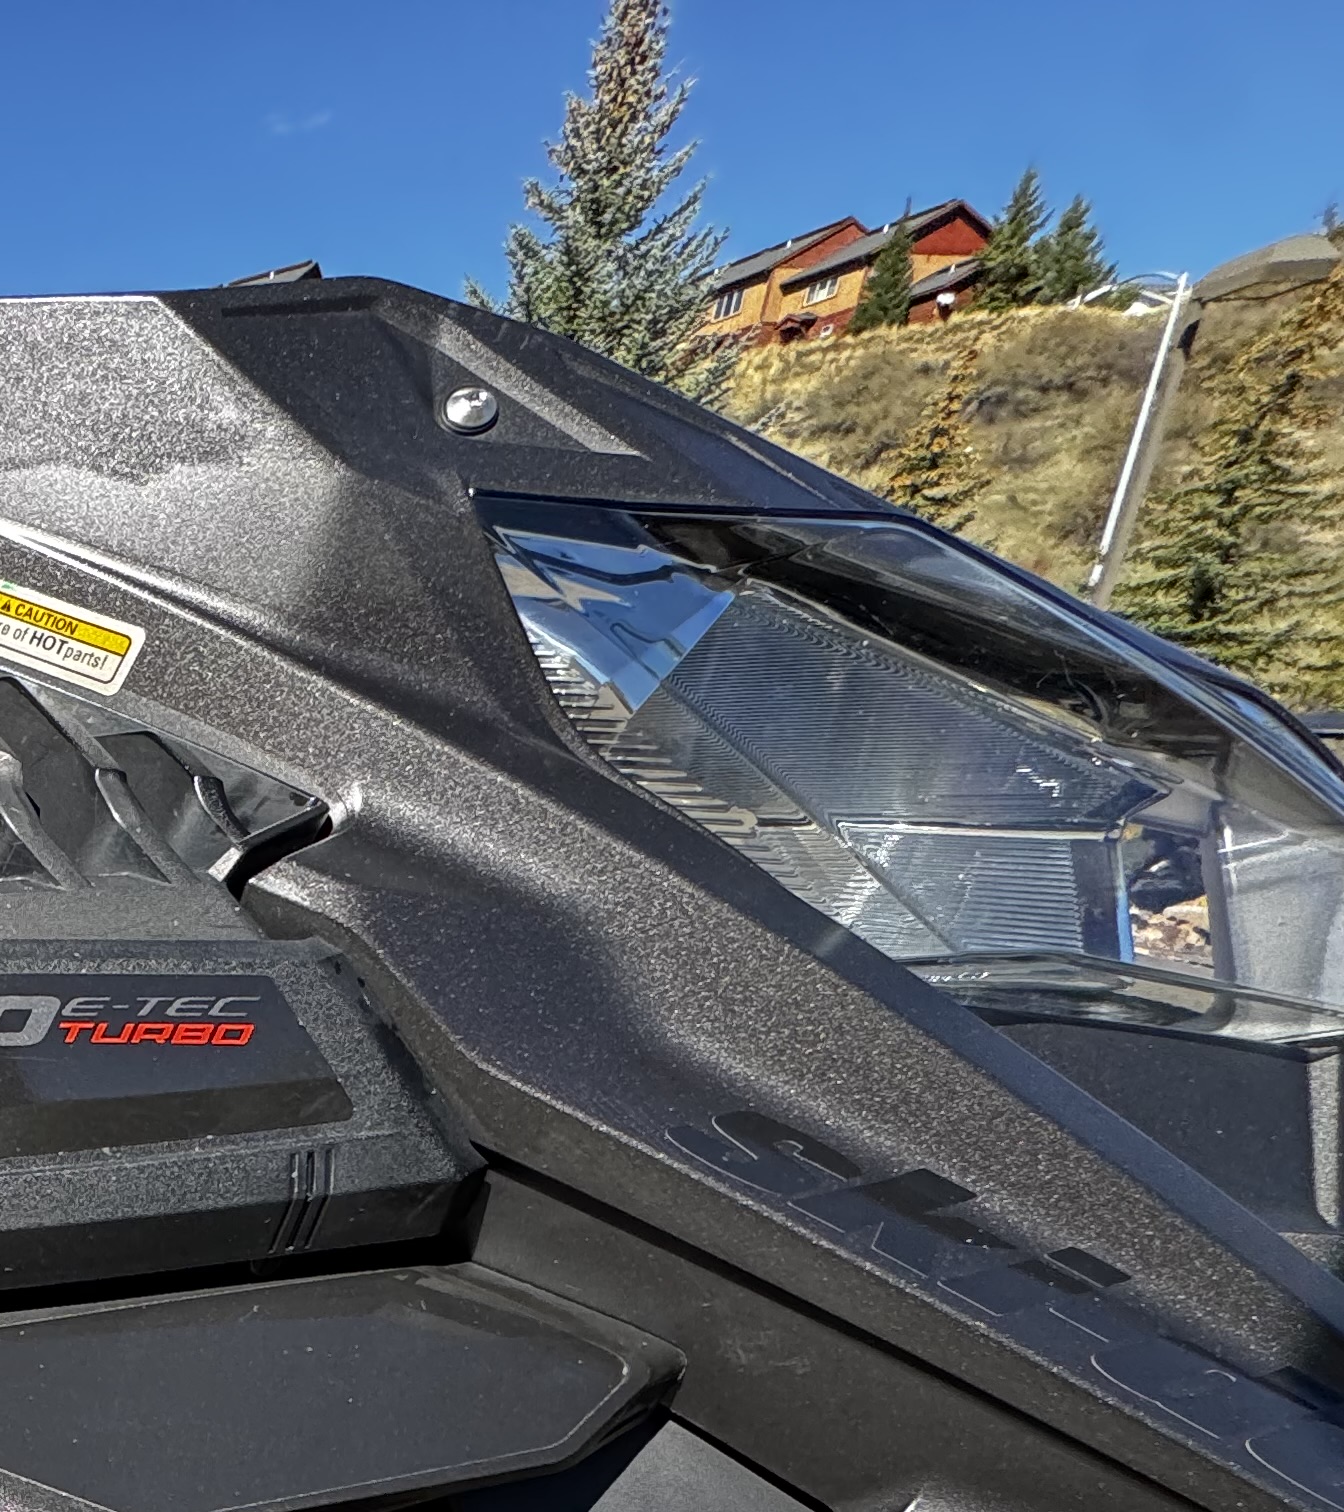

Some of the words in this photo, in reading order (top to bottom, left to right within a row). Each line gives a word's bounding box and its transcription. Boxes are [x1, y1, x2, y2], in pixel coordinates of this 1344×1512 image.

[14, 603, 79, 635] CAUTION
[13, 627, 29, 642] of
[29, 630, 69, 657] HOT
[62, 645, 109, 670] parts!
[59, 995, 261, 1017] E-TEC
[58, 1021, 256, 1046] TURBO
